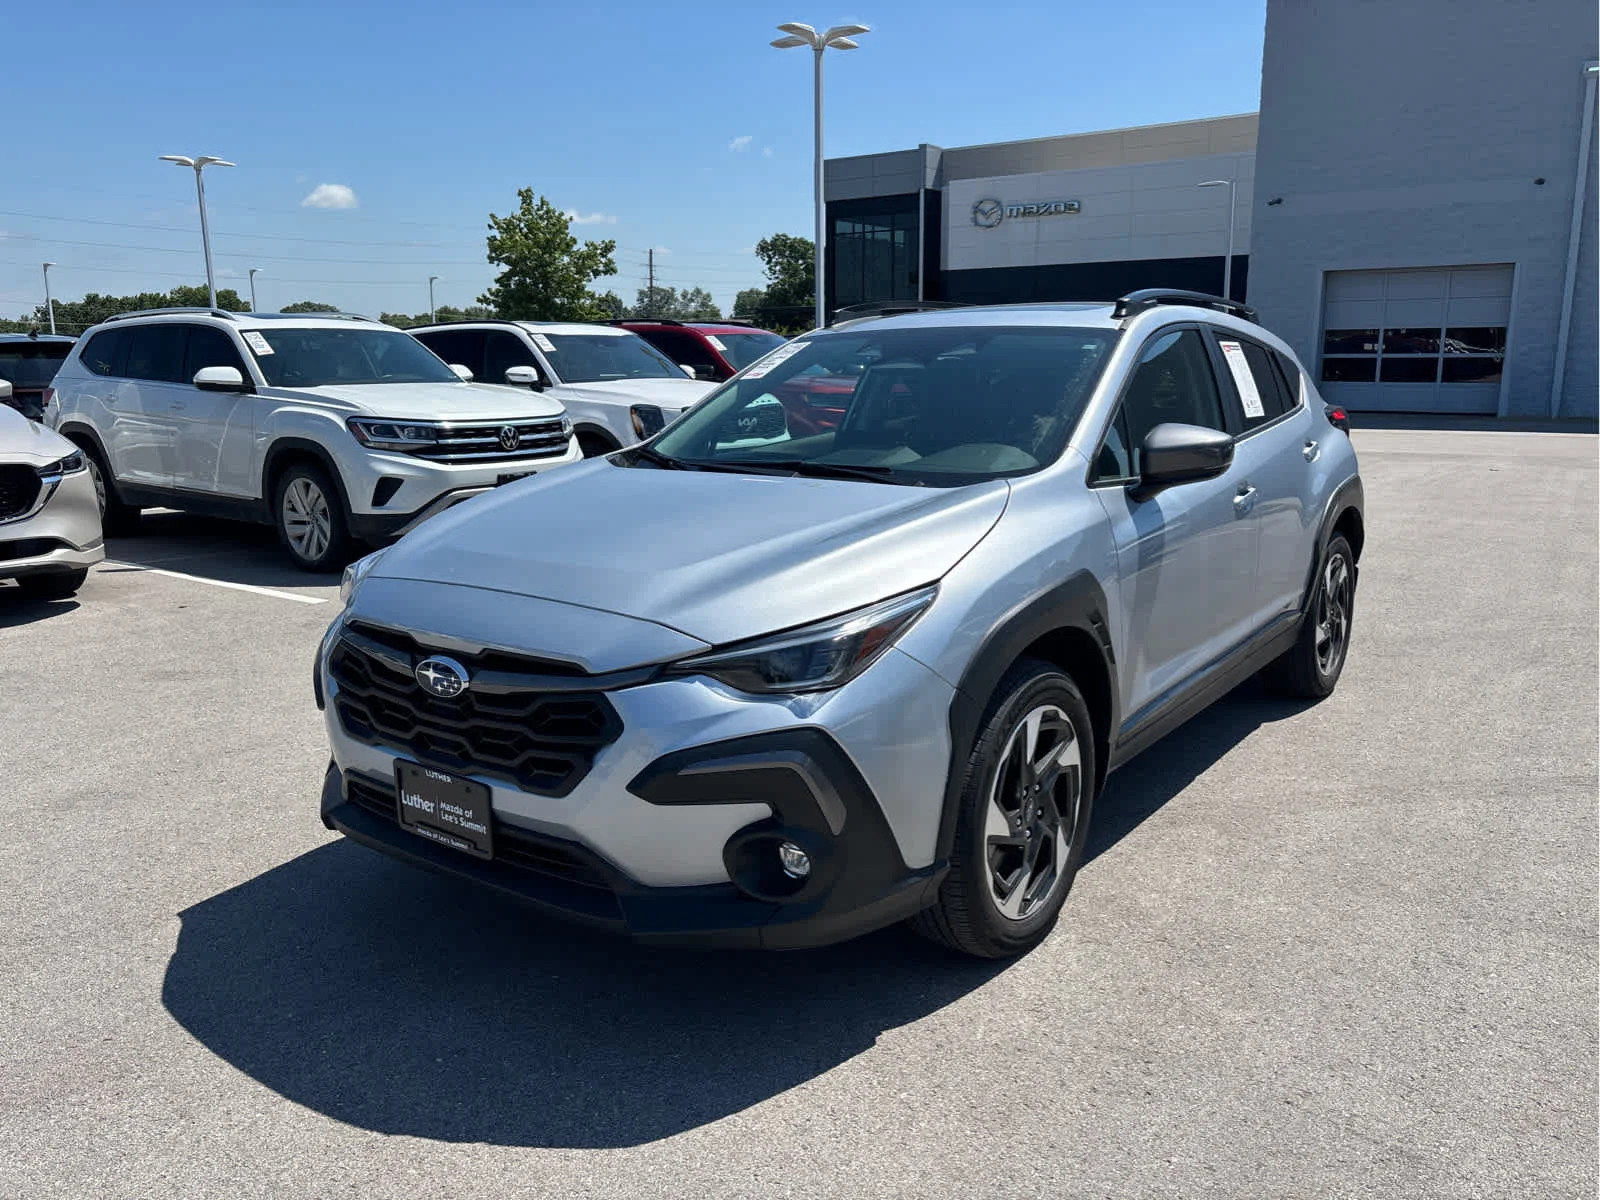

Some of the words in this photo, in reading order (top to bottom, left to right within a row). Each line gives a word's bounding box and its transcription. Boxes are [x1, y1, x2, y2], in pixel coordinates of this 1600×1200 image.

[425, 769, 452, 783] LUTHER
[401, 789, 435, 813] Luther
[440, 802, 462, 815] Mazda
[464, 809, 473, 819] of
[441, 811, 458, 825] Lee's
[460, 818, 487, 835] Summit
